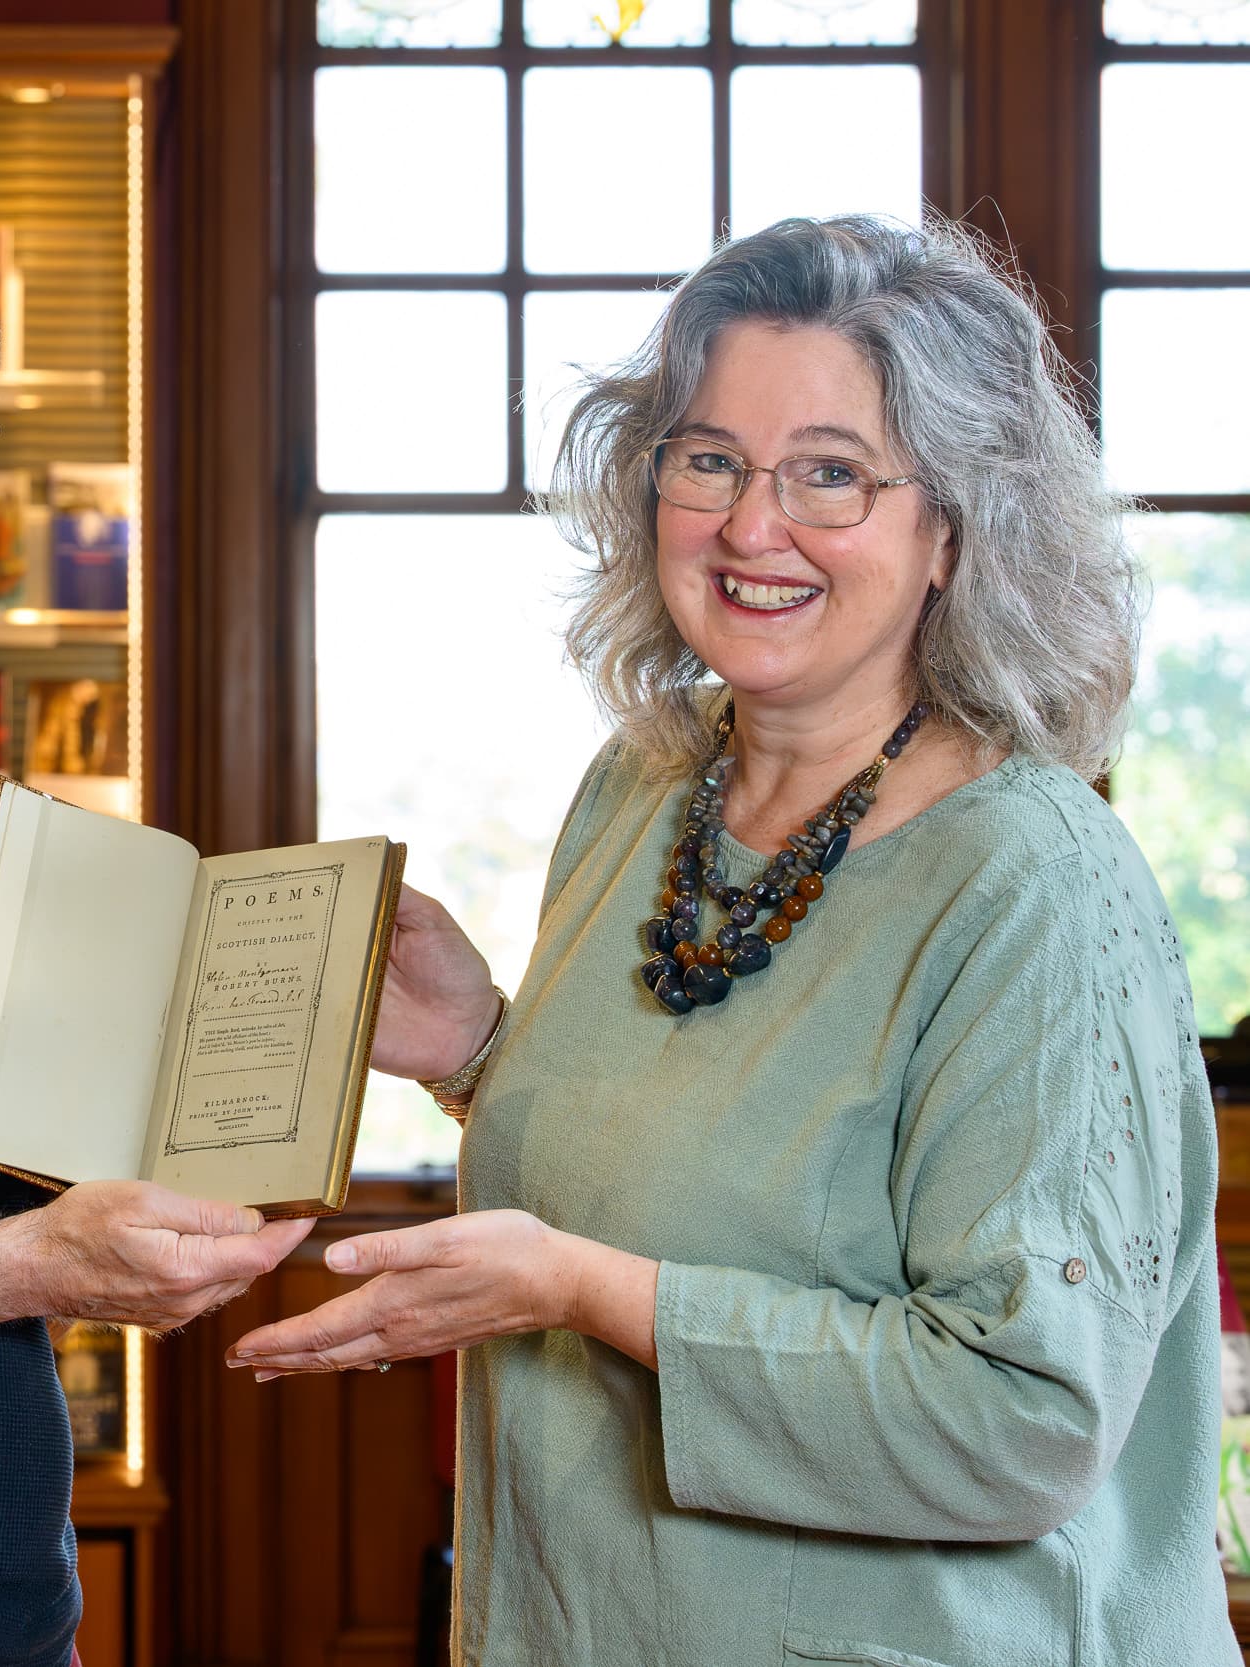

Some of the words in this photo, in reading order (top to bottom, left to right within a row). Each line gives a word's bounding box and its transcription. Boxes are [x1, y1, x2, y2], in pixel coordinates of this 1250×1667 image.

[216, 937, 266, 950] SCOTTISH
[214, 980, 259, 992] ROBERT
[233, 1107, 252, 1115] JOHN
